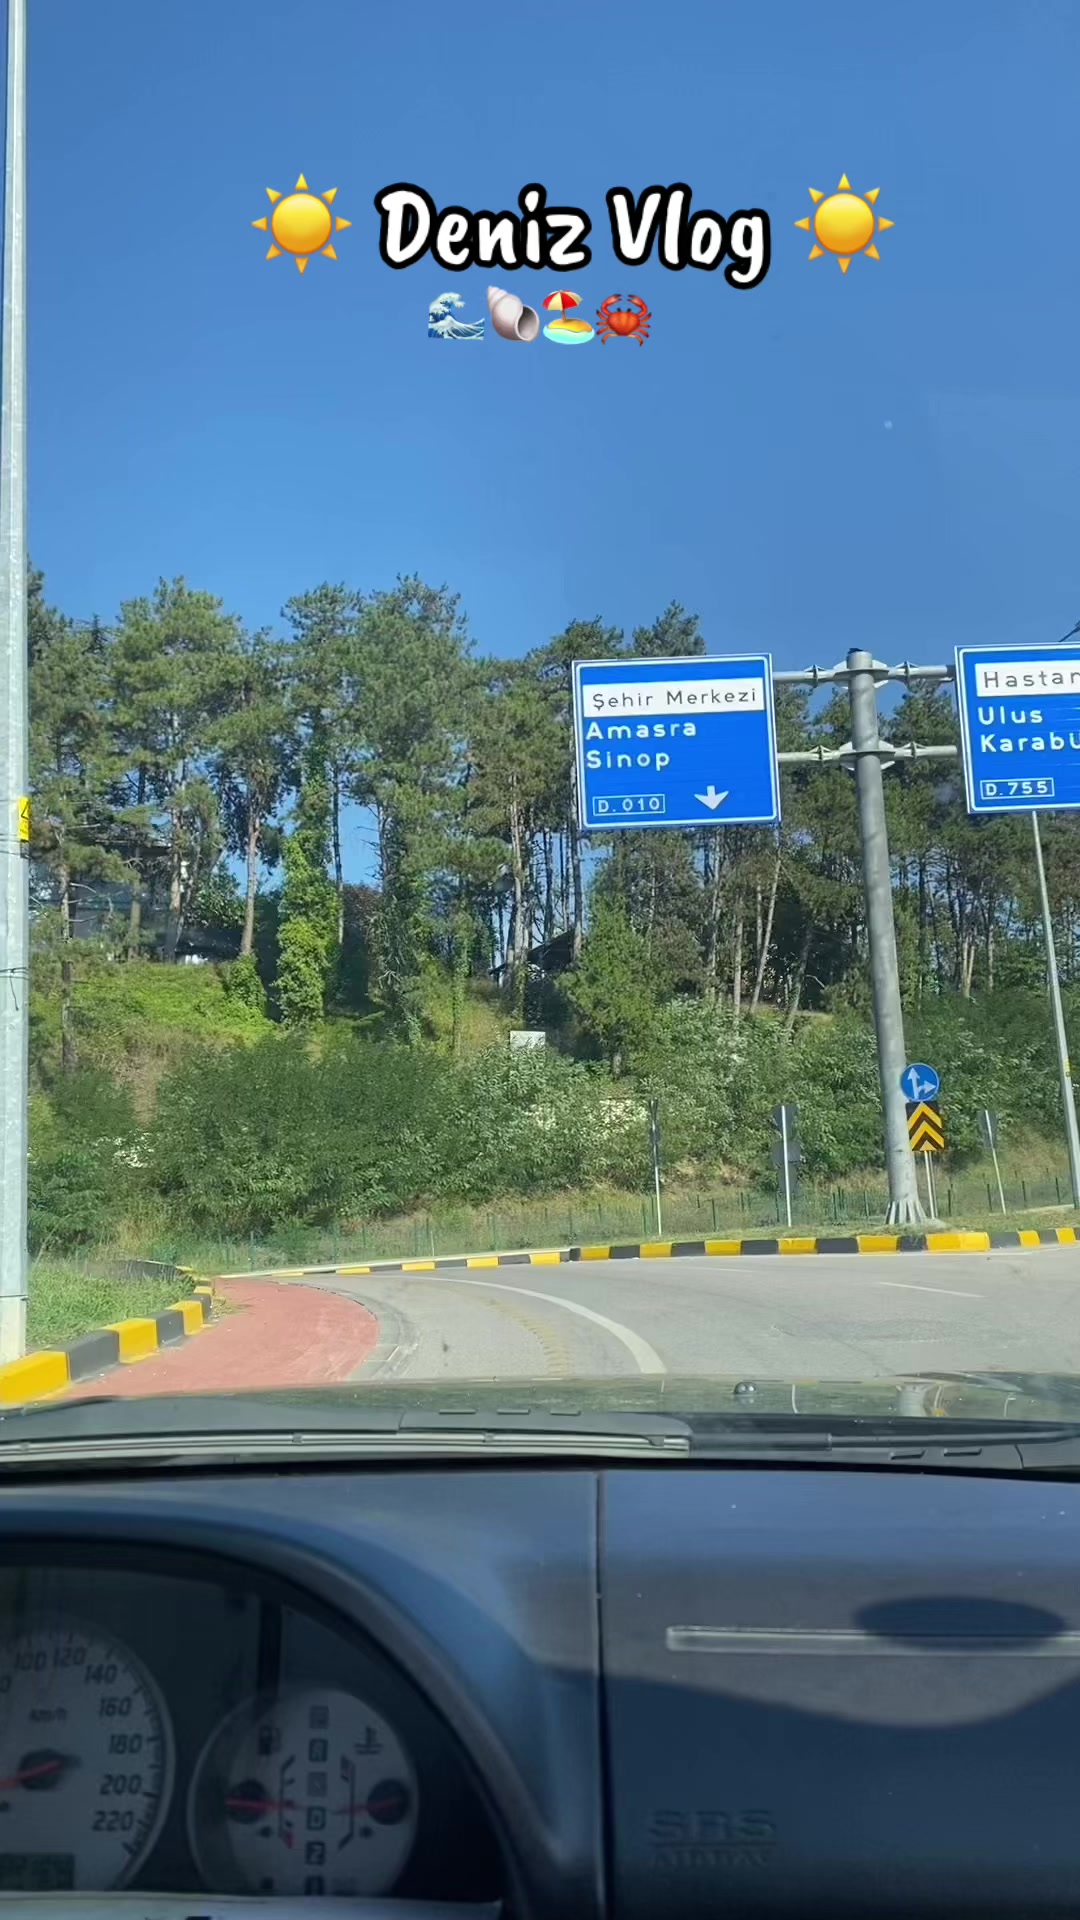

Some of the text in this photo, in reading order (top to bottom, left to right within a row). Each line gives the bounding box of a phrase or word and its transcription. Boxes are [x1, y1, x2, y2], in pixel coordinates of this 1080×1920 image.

[593, 688, 756, 711] Şehir Merkezi
[978, 705, 1043, 725] Ulus
[586, 721, 697, 740] Amasra
[586, 750, 670, 771] Sinop
[985, 781, 1048, 796] D.755
[598, 797, 660, 813] D.010
[84, 1664, 118, 1684] 140
[99, 1697, 132, 1717] 160
[108, 1733, 143, 1753] 180
[99, 1774, 142, 1795] 200
[91, 1810, 134, 1831] 220
